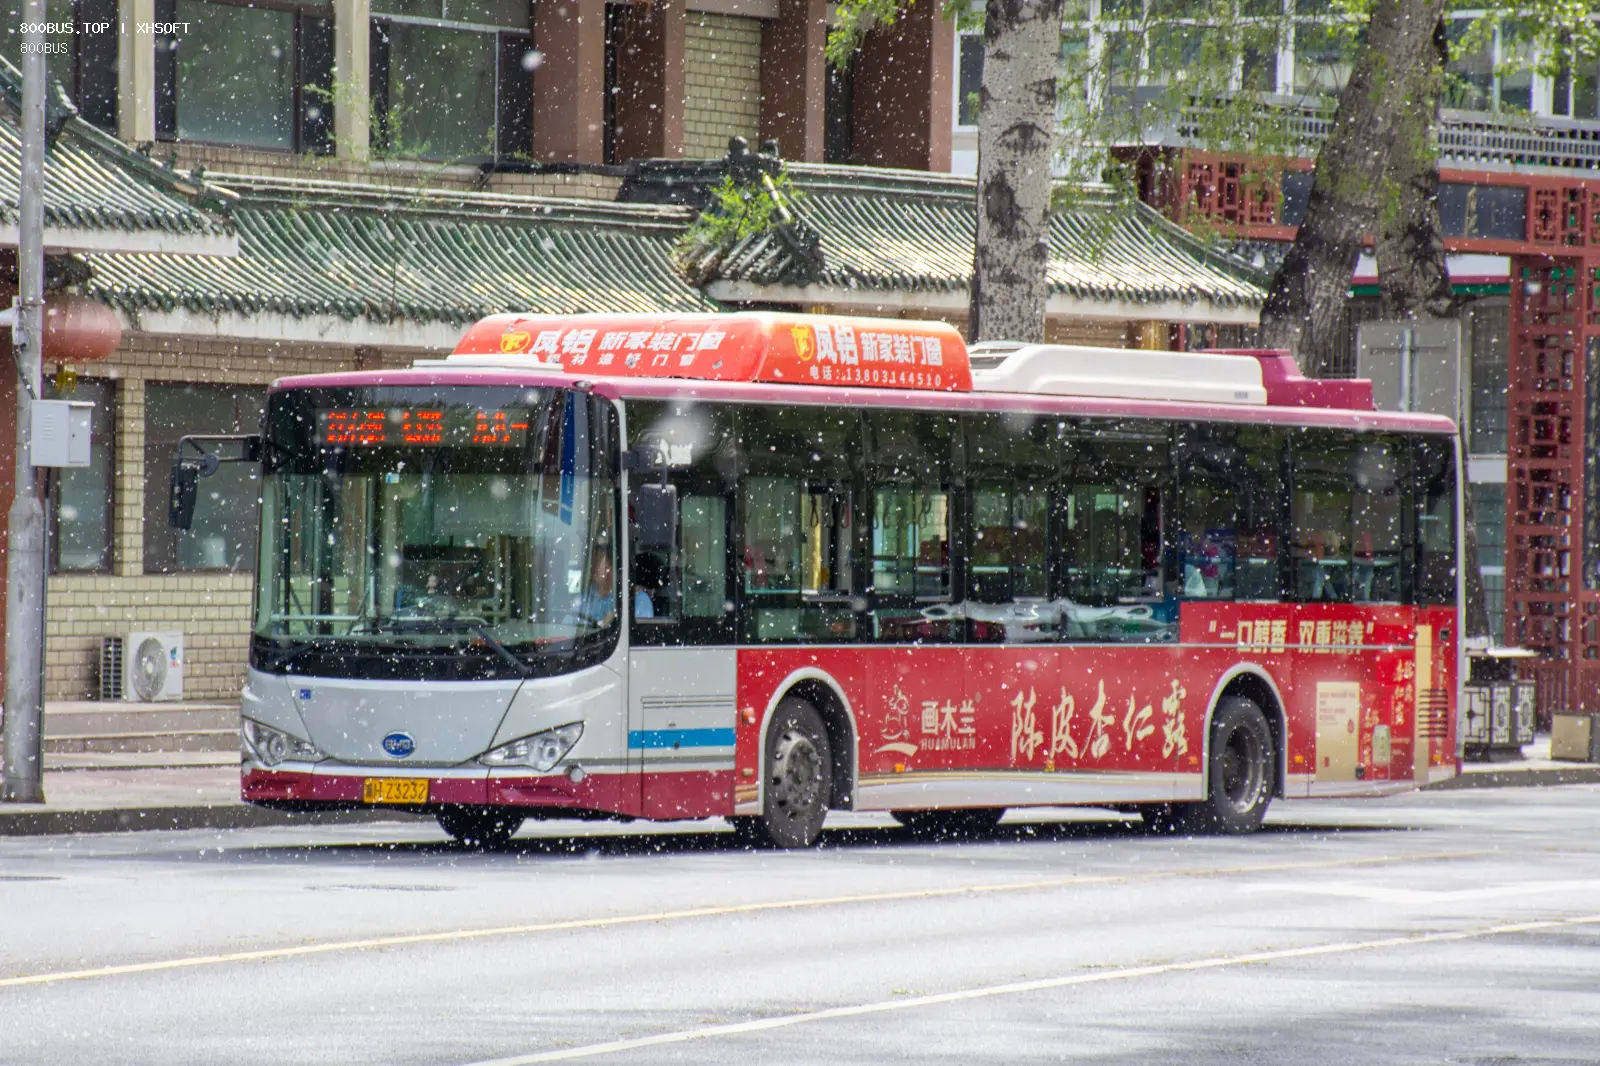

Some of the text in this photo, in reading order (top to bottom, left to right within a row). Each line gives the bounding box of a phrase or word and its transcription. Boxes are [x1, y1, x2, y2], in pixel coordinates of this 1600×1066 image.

[598, 331, 726, 351] 新家装门窗
[860, 331, 943, 367] 新家装门窗
[921, 698, 977, 740] 画木兰
[1010, 678, 1190, 762] 陈皮杏仁露
[920, 737, 977, 751] HUAMULAN
